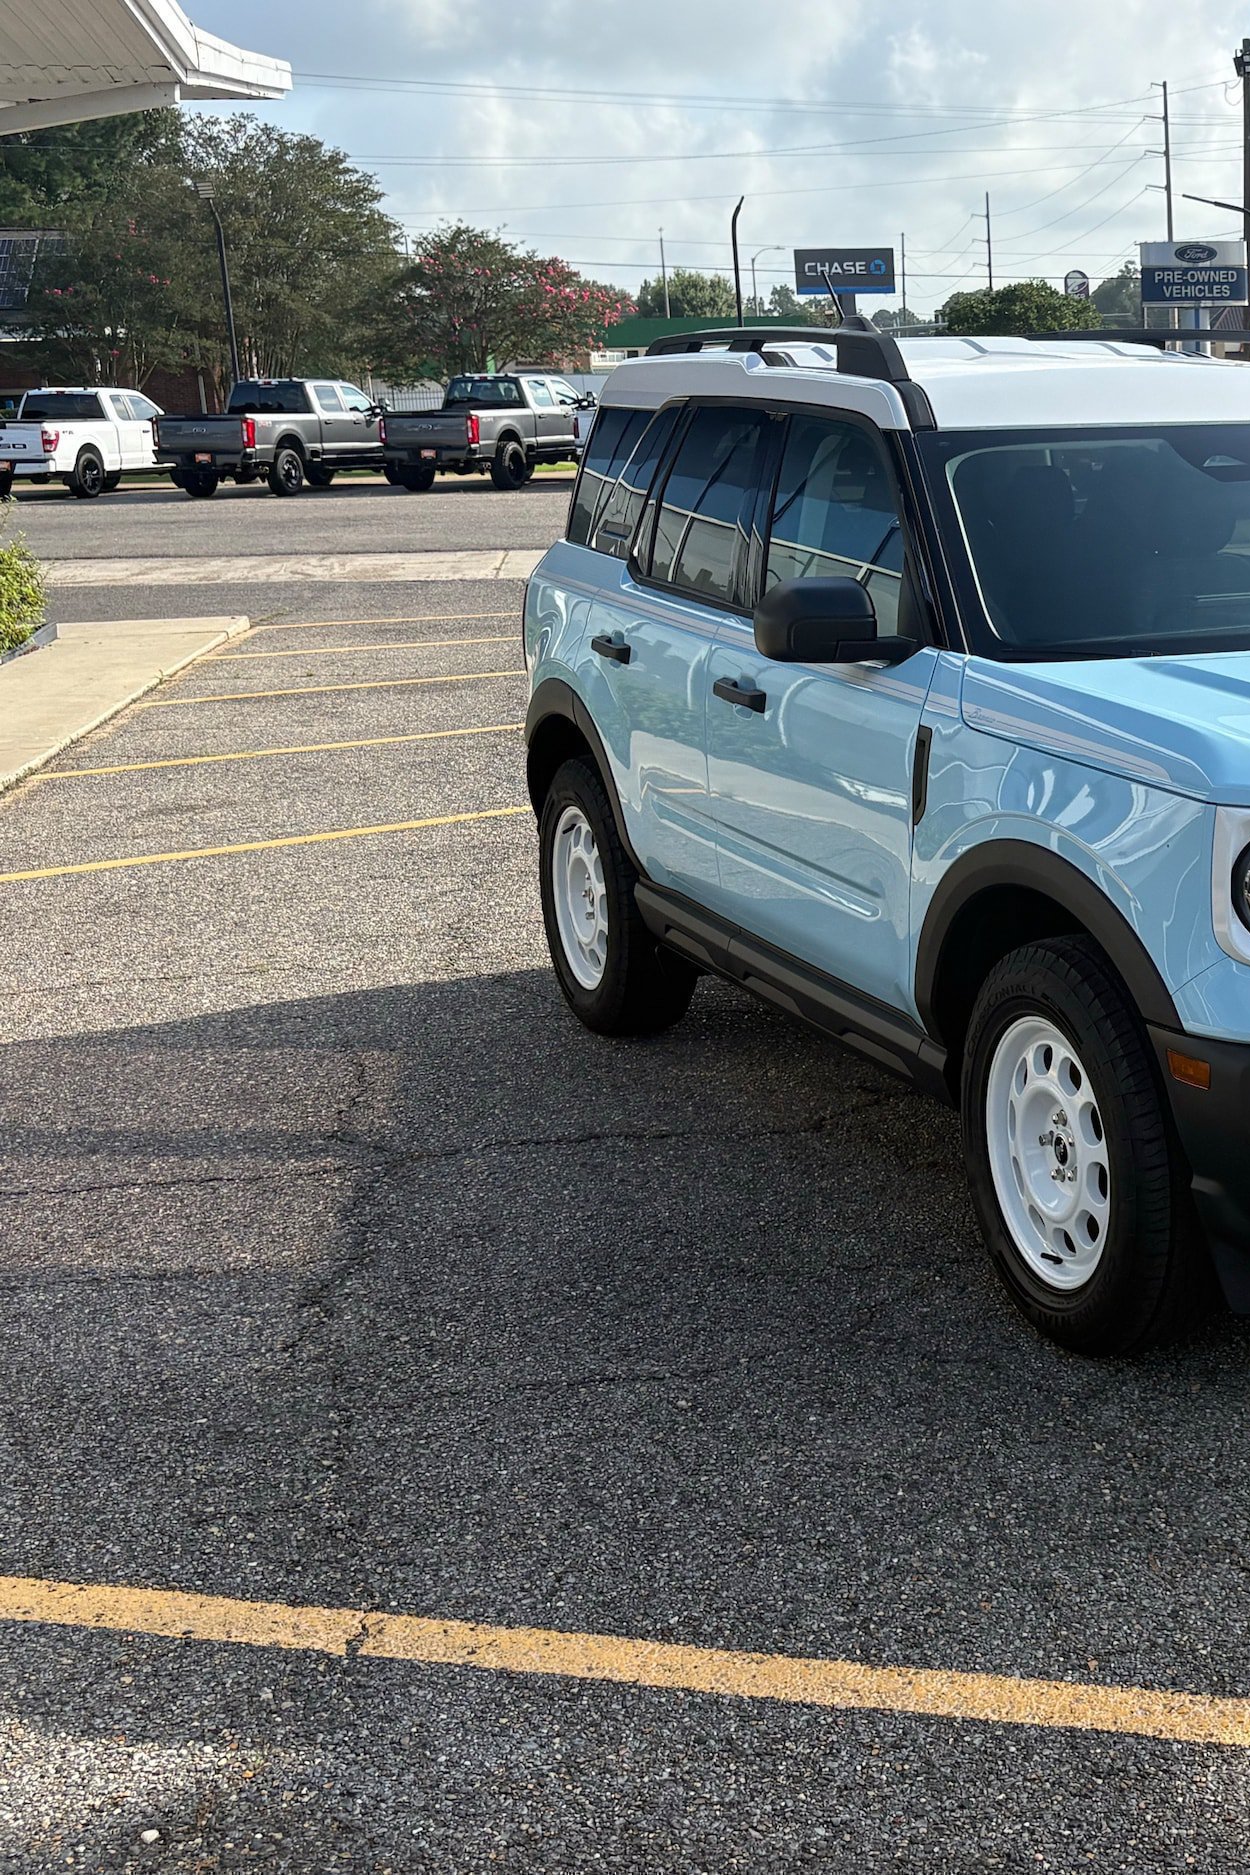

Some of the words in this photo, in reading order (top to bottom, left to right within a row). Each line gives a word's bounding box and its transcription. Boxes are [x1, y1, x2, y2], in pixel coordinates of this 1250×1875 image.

[1183, 248, 1209, 259] Ford
[804, 261, 867, 276] CHASE
[1154, 270, 1237, 283] PRE-OWNED
[1163, 285, 1231, 298] VEHICLES
